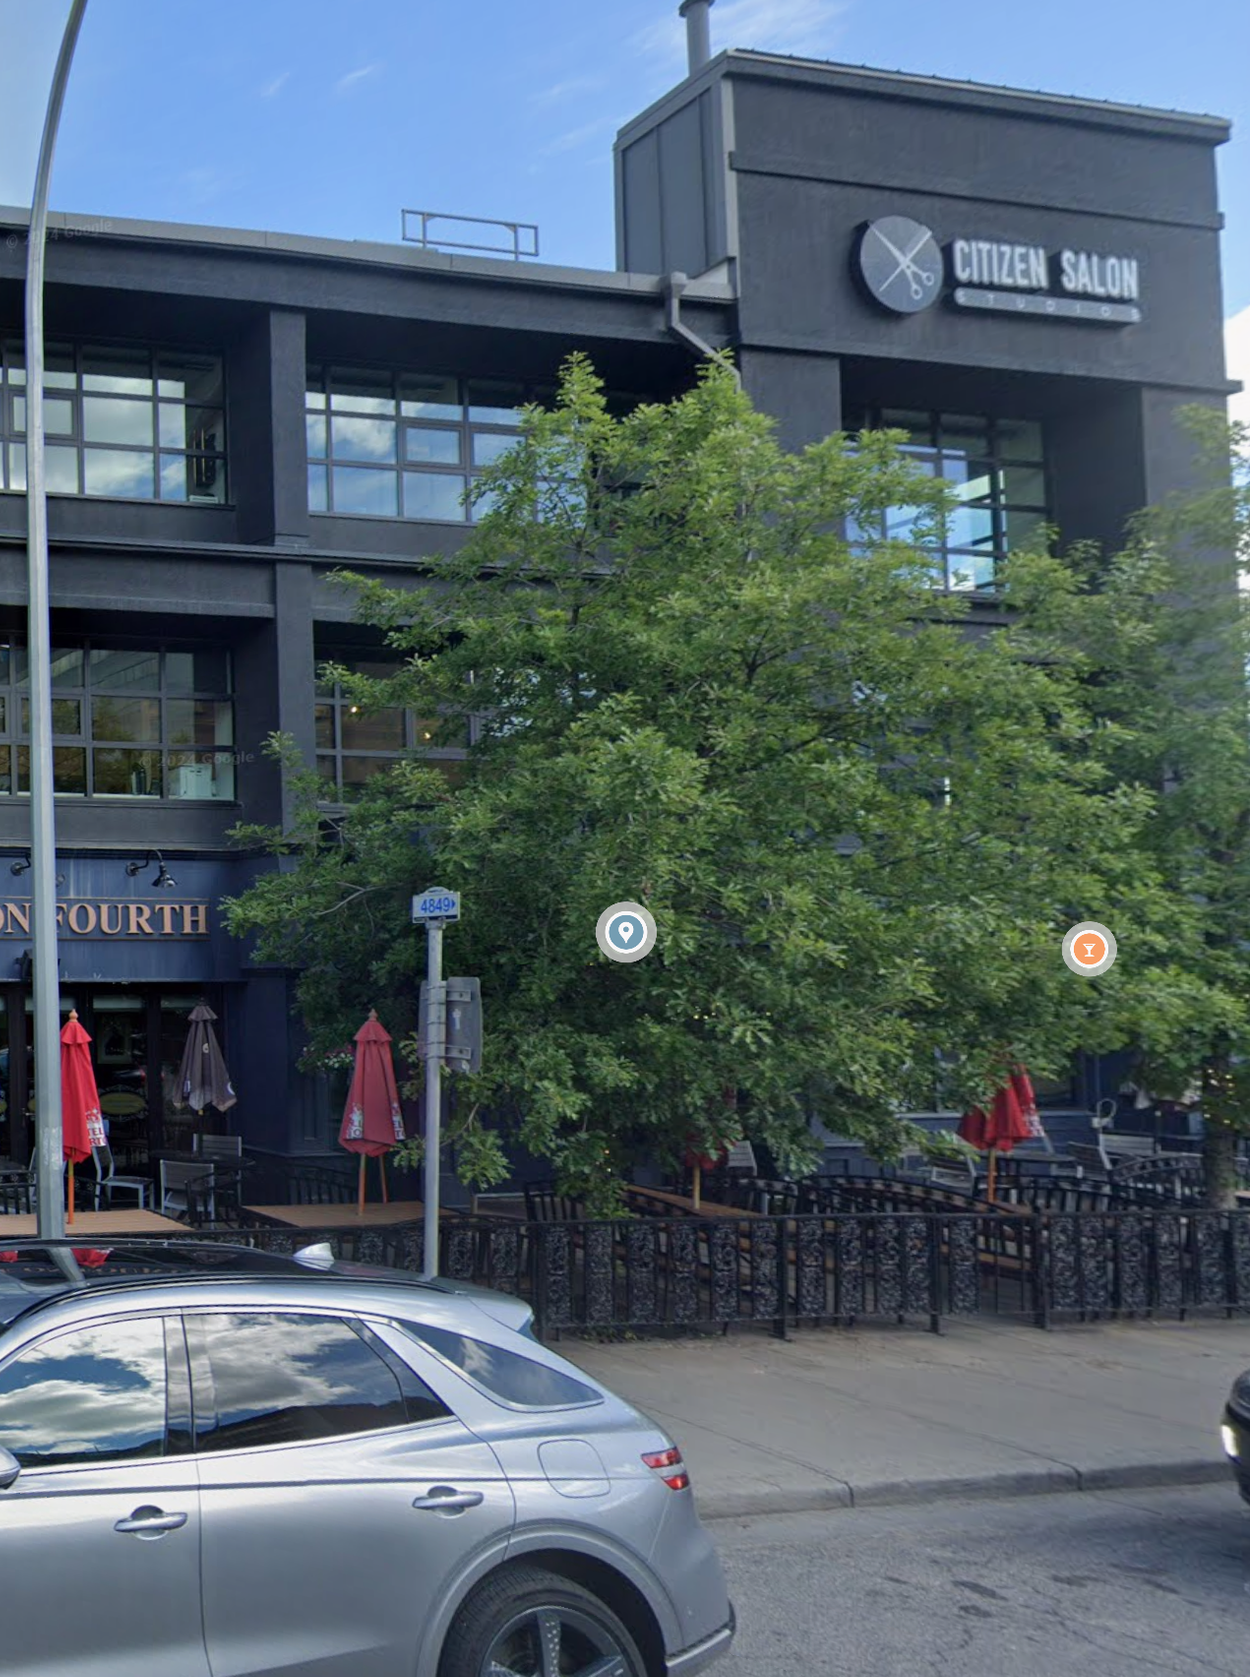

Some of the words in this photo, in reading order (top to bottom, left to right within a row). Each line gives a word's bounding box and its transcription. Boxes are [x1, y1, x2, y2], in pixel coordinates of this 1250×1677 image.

[954, 239, 1049, 290] CITIZEN
[1061, 249, 1138, 300] SALON
[956, 290, 1141, 321] STUDIOS
[55, 903, 209, 935] FOURTH
[421, 897, 449, 913] 4849
